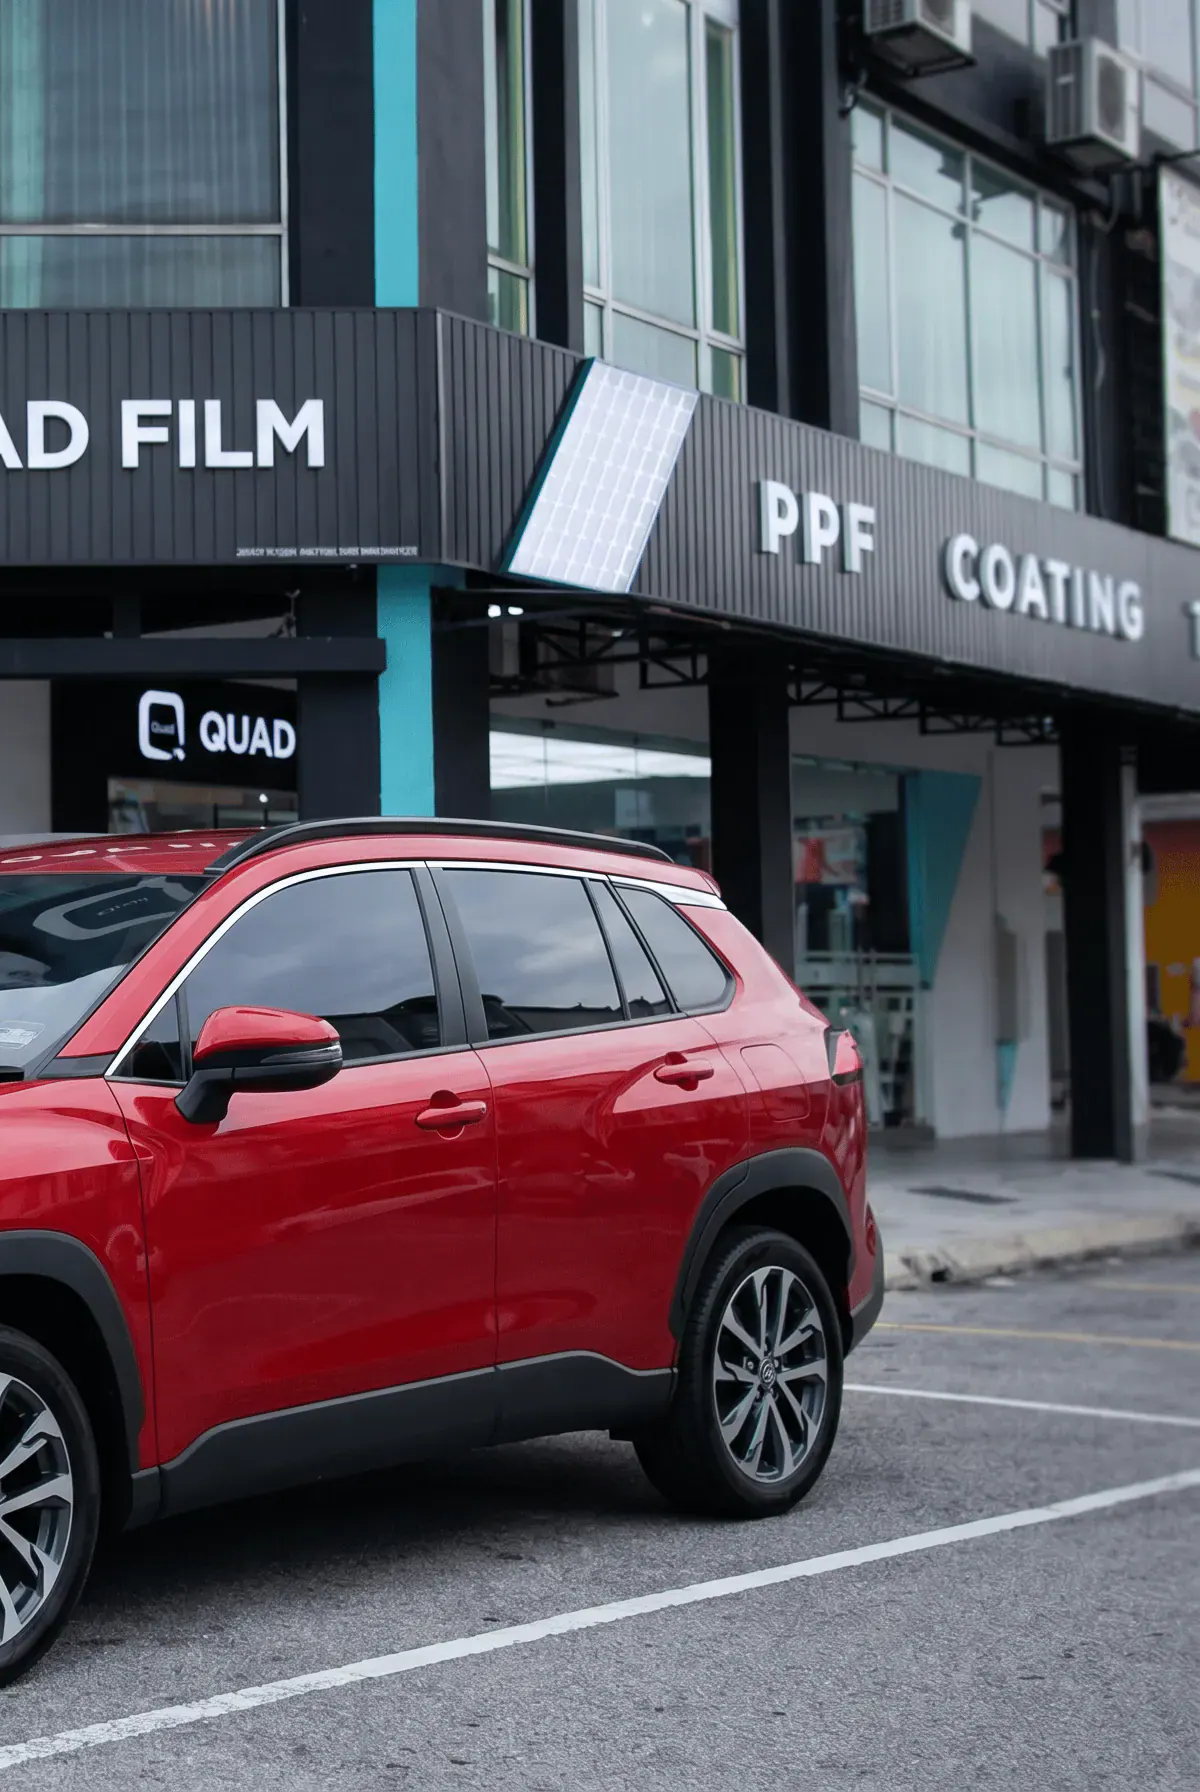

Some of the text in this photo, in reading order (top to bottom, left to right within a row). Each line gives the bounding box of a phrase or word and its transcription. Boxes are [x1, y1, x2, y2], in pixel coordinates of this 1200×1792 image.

[121, 399, 325, 470] FILM
[759, 479, 875, 573] PPF
[944, 533, 1145, 641] COATING
[199, 710, 296, 759] QUAD
